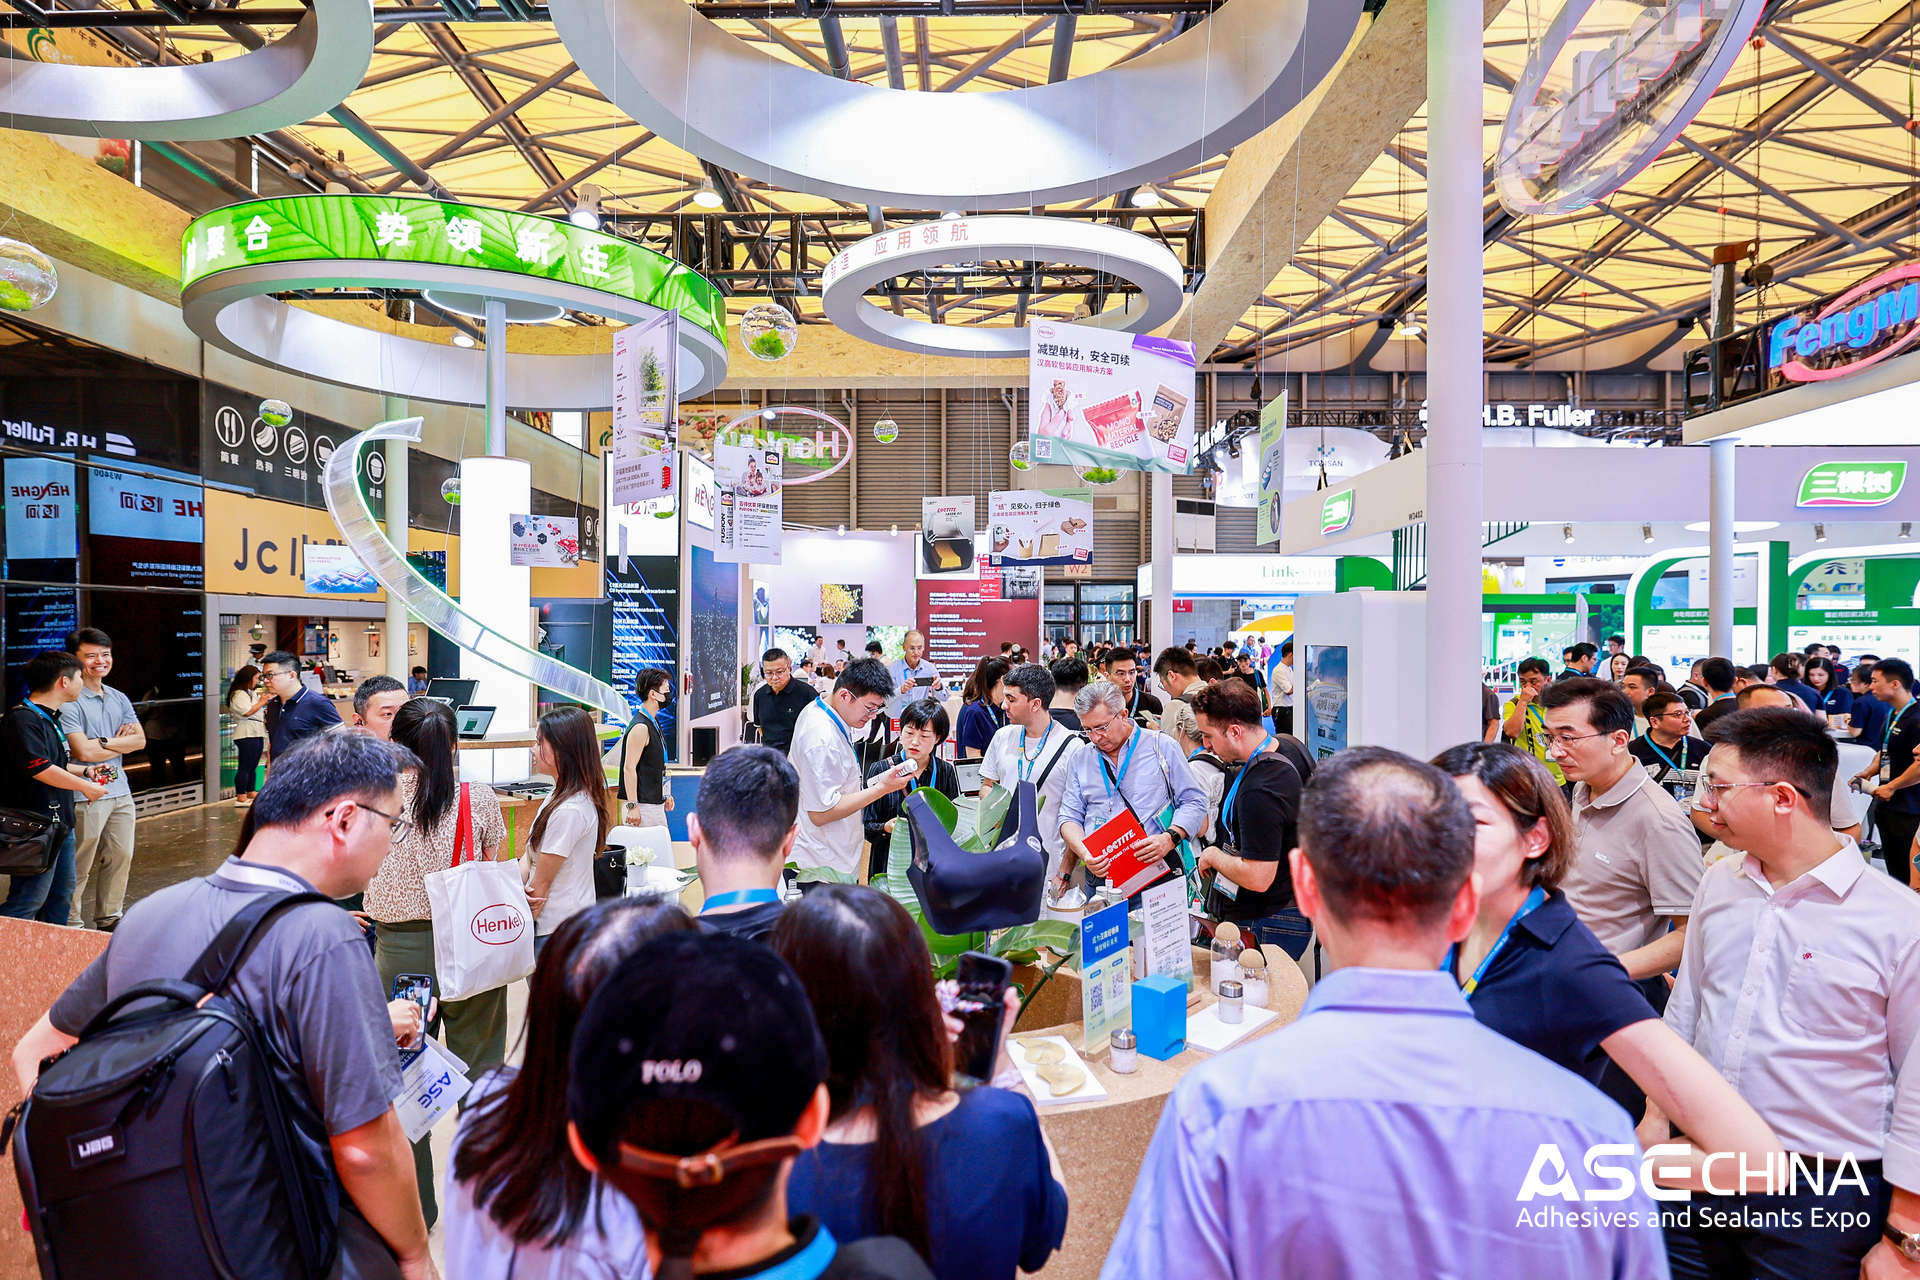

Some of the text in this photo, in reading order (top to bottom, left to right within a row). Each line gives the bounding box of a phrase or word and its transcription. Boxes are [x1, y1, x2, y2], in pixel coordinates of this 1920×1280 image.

[375, 211, 610, 279] 势领新生
[874, 222, 969, 256] 应用领航
[1527, 404, 1595, 427] Fuller
[1110, 434, 1139, 449] RECYCLE
[1101, 829, 1137, 857] LOCTITE
[477, 912, 522, 934] Henkel
[641, 1058, 703, 1084] POLO
[417, 1071, 452, 1109] ASE
